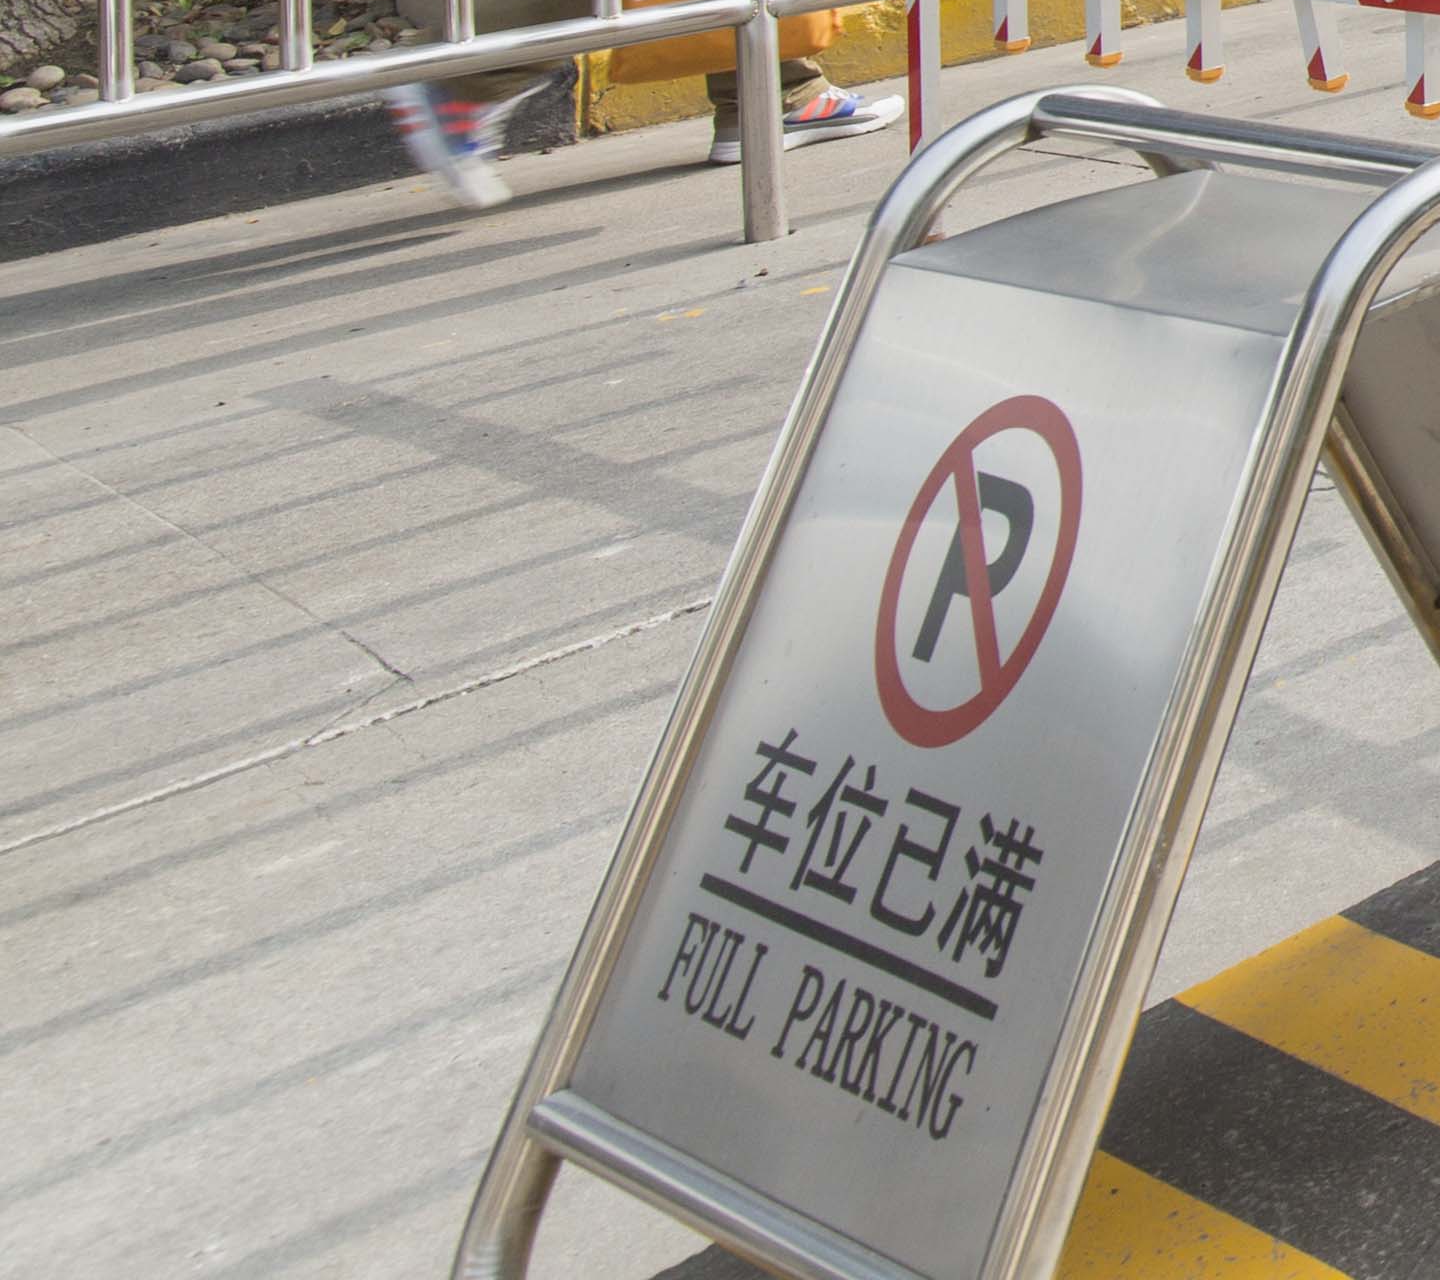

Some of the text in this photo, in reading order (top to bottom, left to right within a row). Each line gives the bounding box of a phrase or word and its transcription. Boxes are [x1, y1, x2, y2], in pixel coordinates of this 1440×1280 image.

[723, 727, 1045, 979] 车位已满
[656, 911, 979, 1140] FULL PARKING
